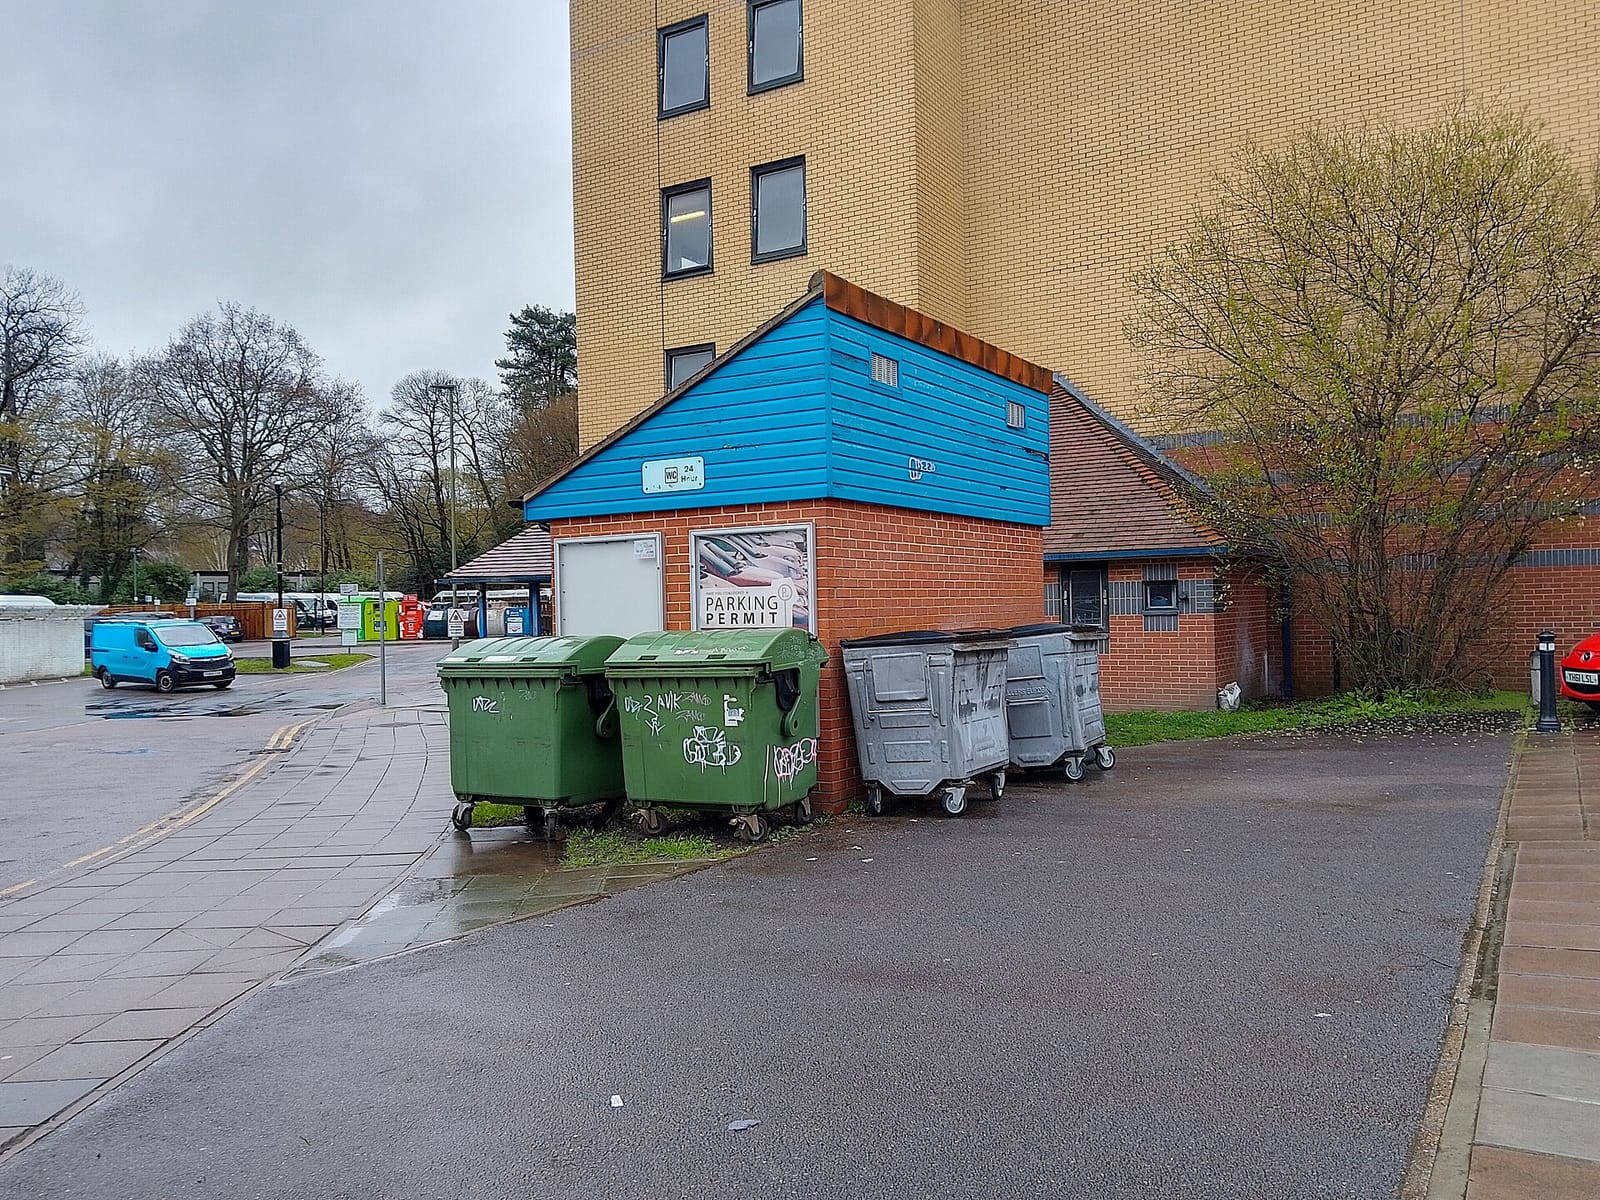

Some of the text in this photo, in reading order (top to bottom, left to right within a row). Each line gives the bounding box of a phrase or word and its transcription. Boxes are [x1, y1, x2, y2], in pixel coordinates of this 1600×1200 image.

[683, 465, 694, 473] 24
[666, 470, 677, 480] WC
[706, 595, 778, 611] PARKING
[706, 612, 778, 624] PERMIT
